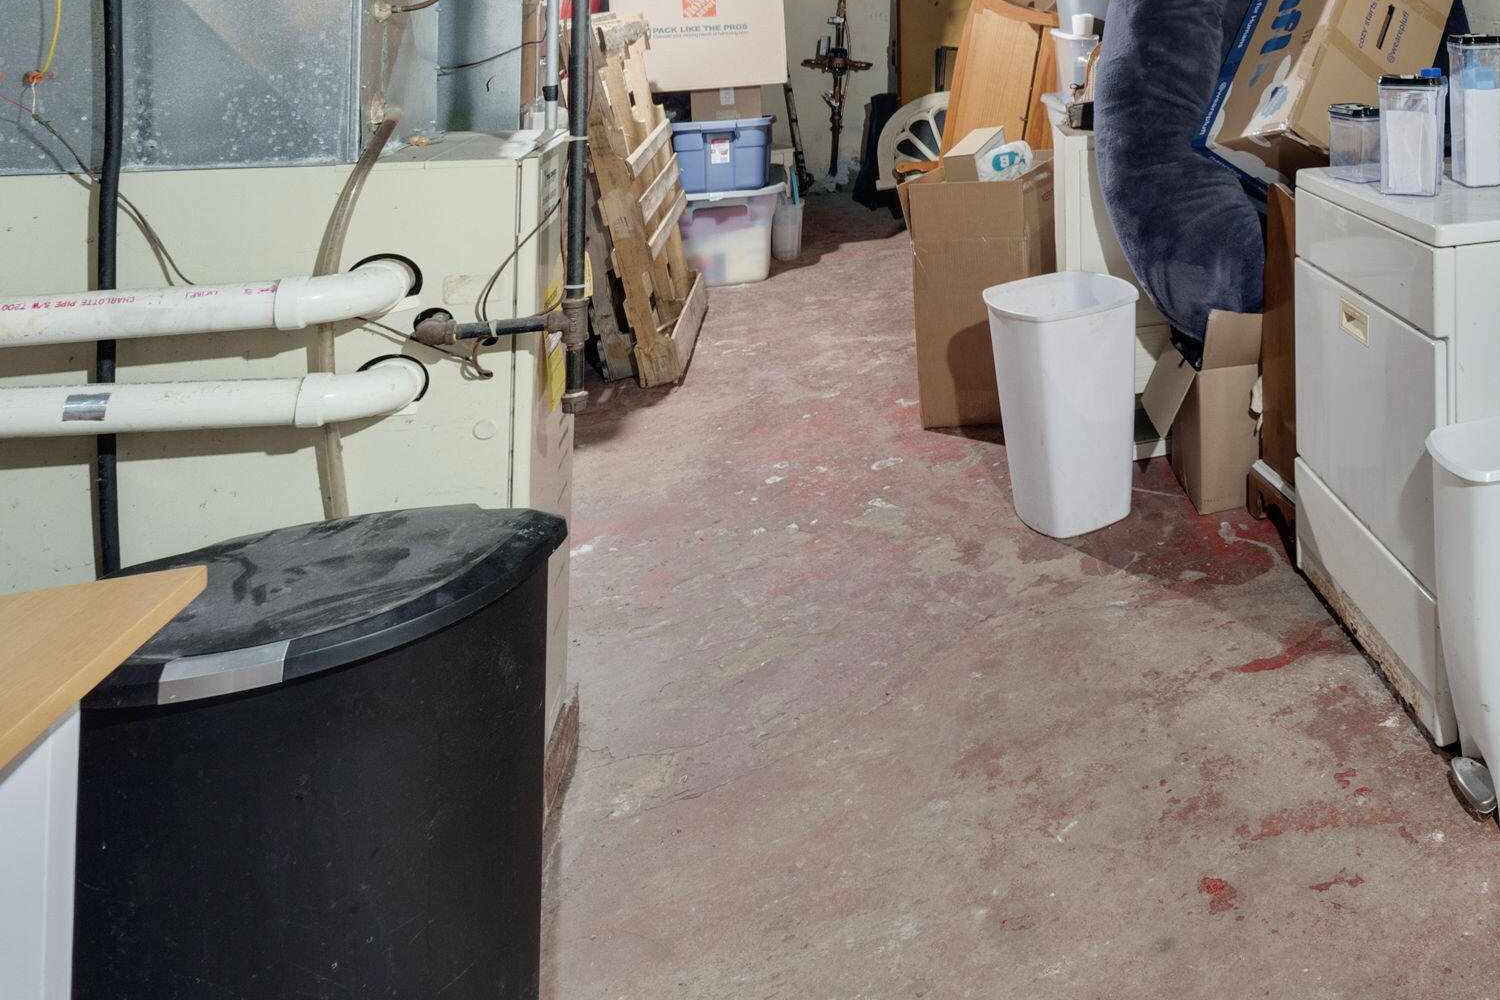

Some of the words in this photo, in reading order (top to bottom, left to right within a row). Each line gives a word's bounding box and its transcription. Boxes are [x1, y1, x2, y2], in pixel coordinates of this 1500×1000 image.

[652, 26, 677, 34] PACK
[680, 25, 701, 33] LIKE
[703, 24, 721, 32] THE
[723, 23, 748, 31] PROS
[1358, 27, 1368, 49] cozy
[1364, 1, 1378, 26] starts
[1237, 15, 1256, 49] Humans
[55, 300, 77, 308] PIPE
[80, 296, 135, 306] CHARLOTTE
